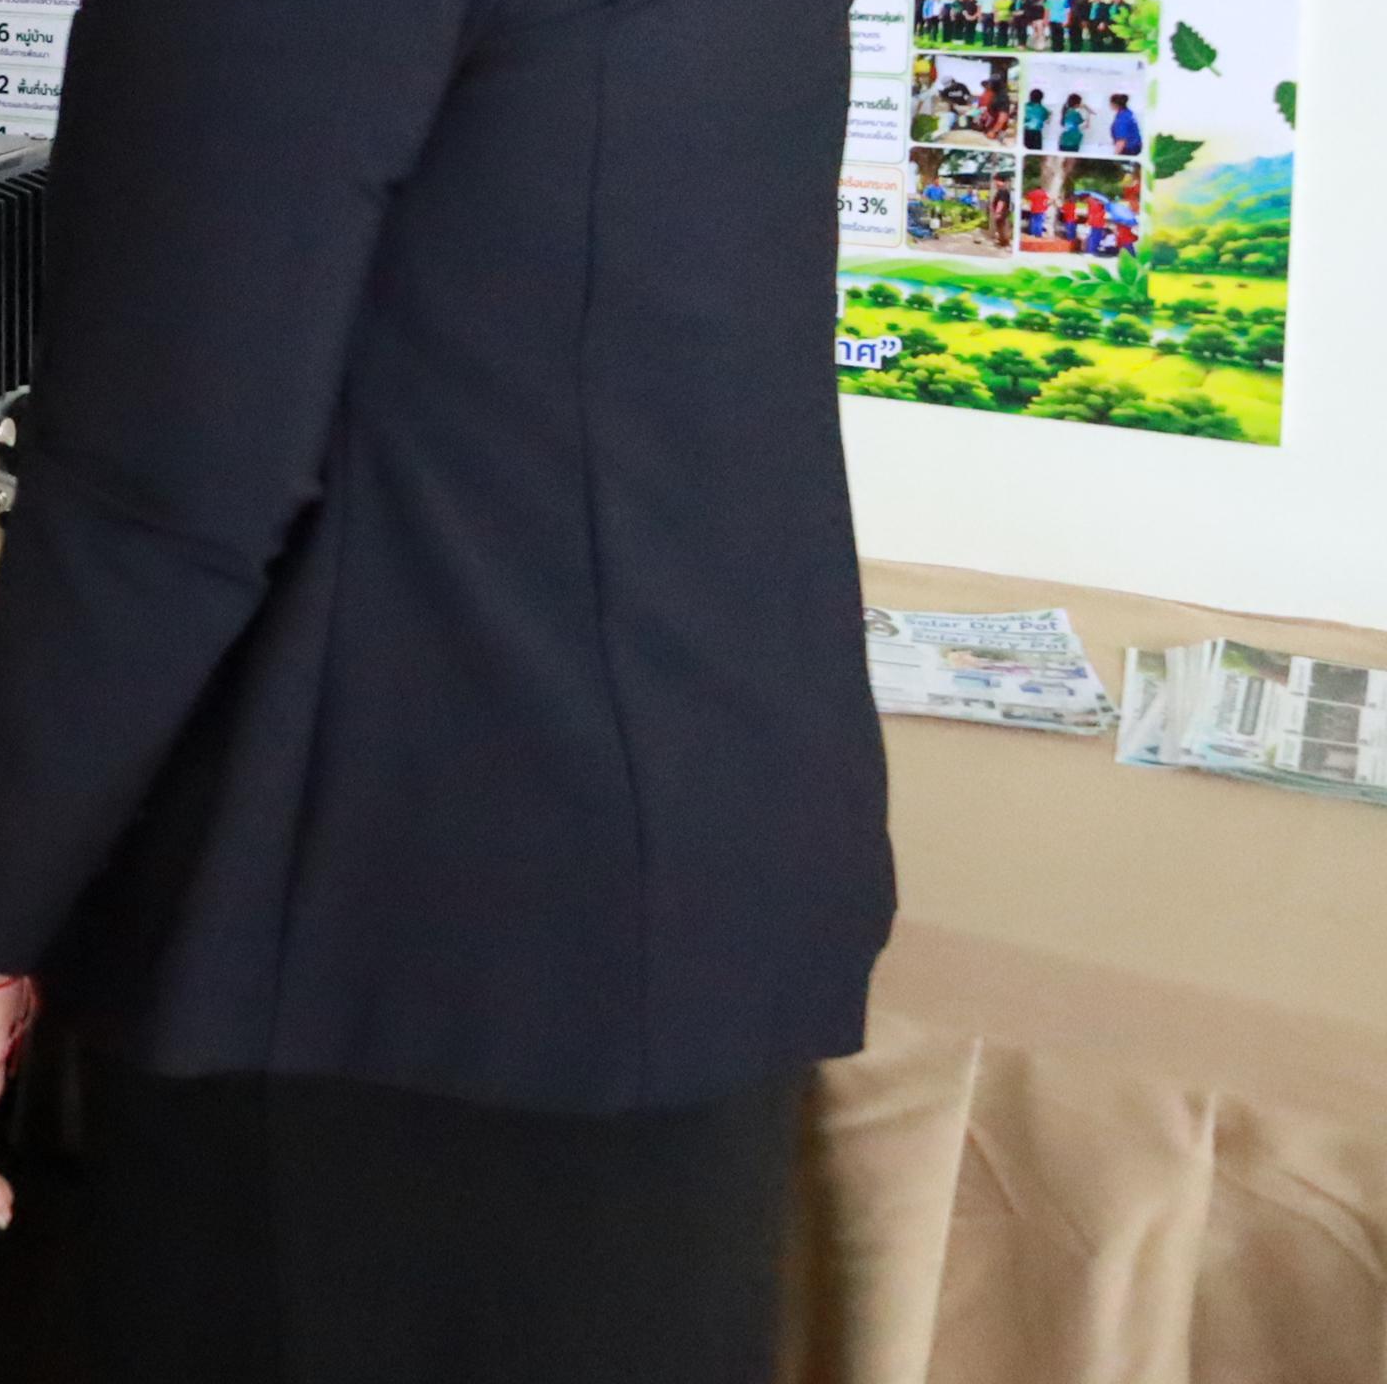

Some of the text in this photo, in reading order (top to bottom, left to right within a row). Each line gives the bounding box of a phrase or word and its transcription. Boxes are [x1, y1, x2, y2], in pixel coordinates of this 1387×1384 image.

[15, 29, 54, 47] หมู่บ้าน
[859, 196, 888, 215] 3%
[838, 338, 897, 364] าศ”
